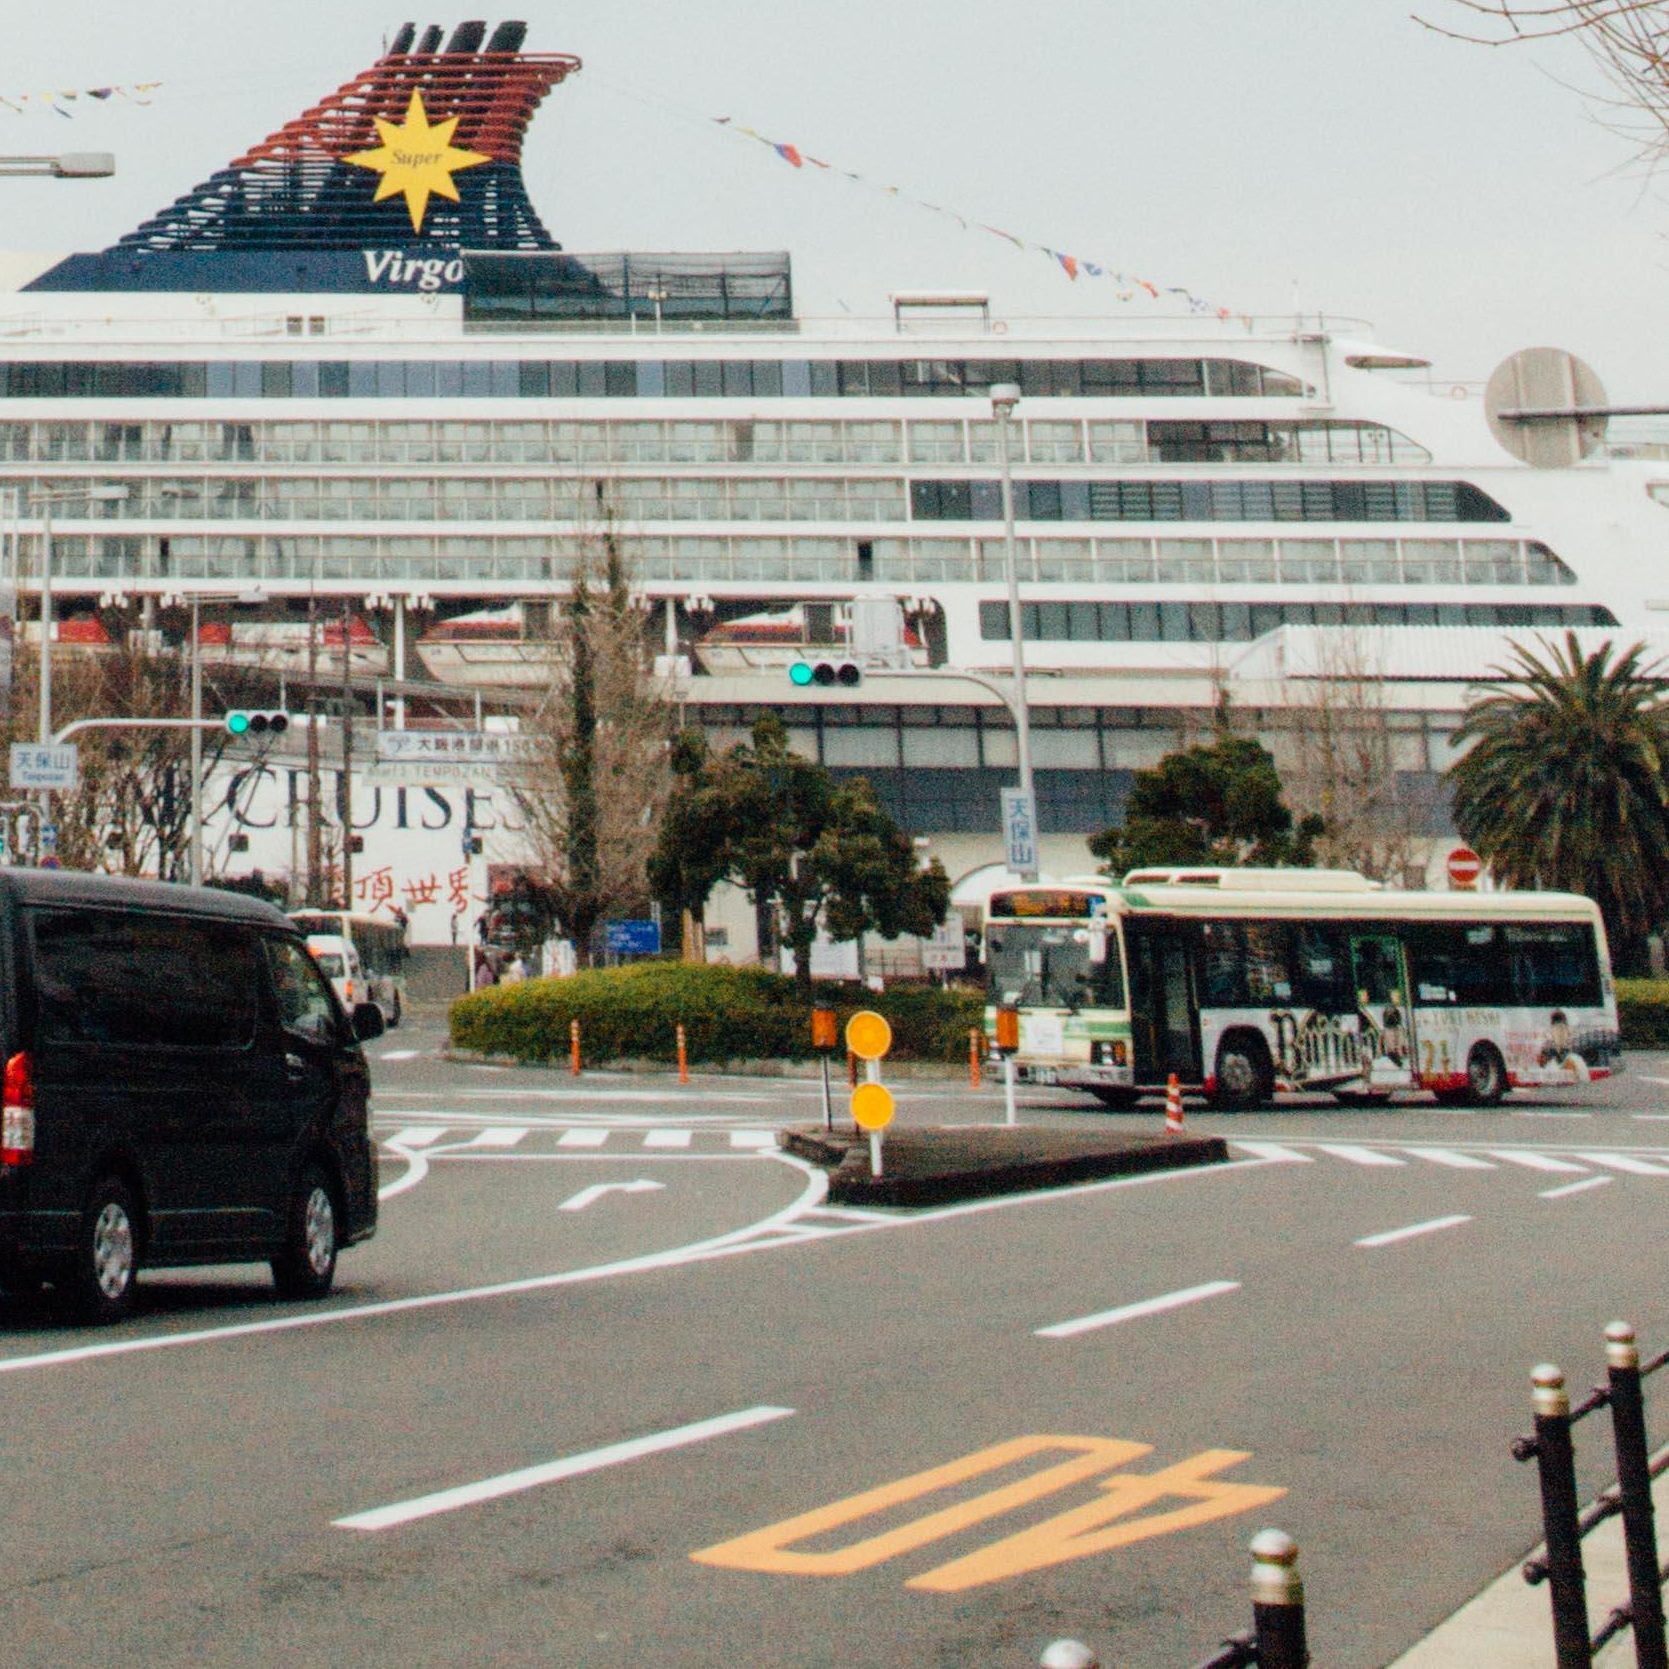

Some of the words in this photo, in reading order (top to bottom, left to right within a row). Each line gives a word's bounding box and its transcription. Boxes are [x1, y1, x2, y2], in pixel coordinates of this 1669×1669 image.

[392, 149, 443, 169] Super
[363, 250, 464, 291] Virgo
[17, 751, 70, 770] 天保山
[1009, 798, 1034, 864] 天保山
[689, 1434, 1289, 1594] 40
